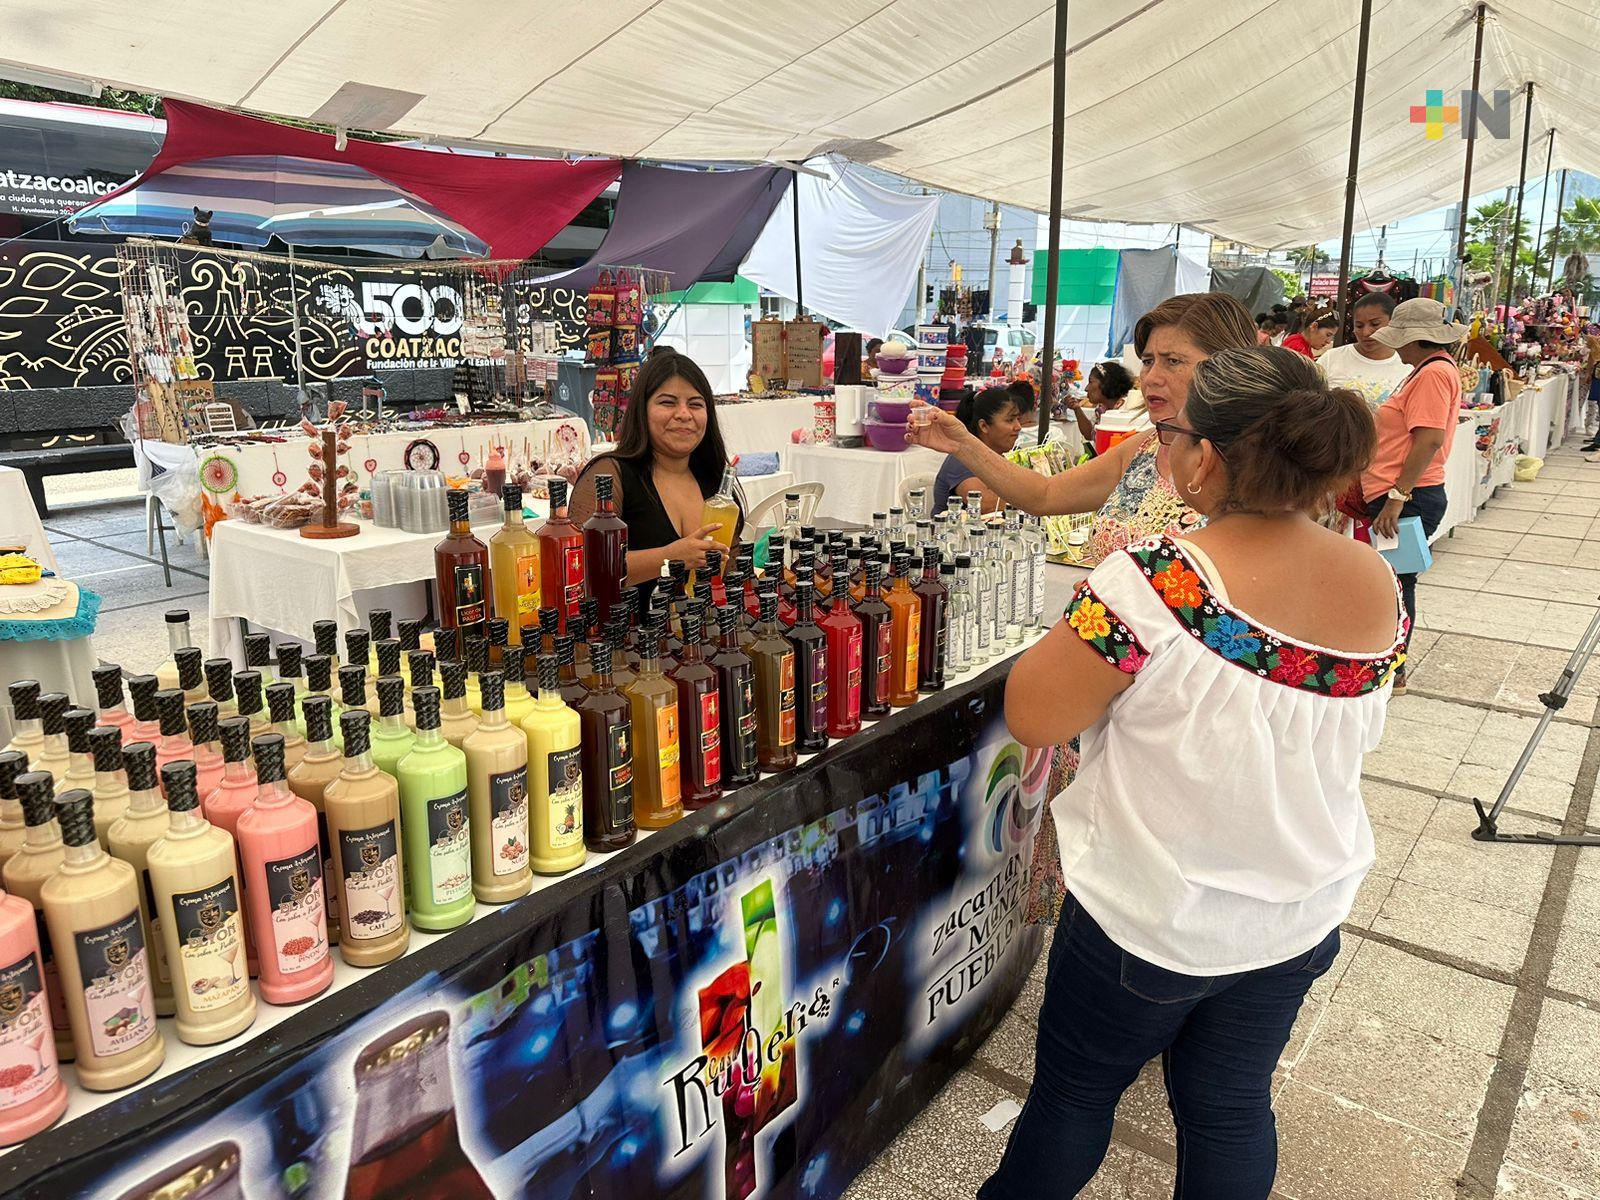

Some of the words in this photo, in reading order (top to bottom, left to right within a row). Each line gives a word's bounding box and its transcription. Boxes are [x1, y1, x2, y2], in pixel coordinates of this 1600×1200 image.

[8, 194, 37, 204] ciudad
[39, 198, 55, 206] que
[57, 199, 91, 208] querem
[353, 281, 464, 335] 500
